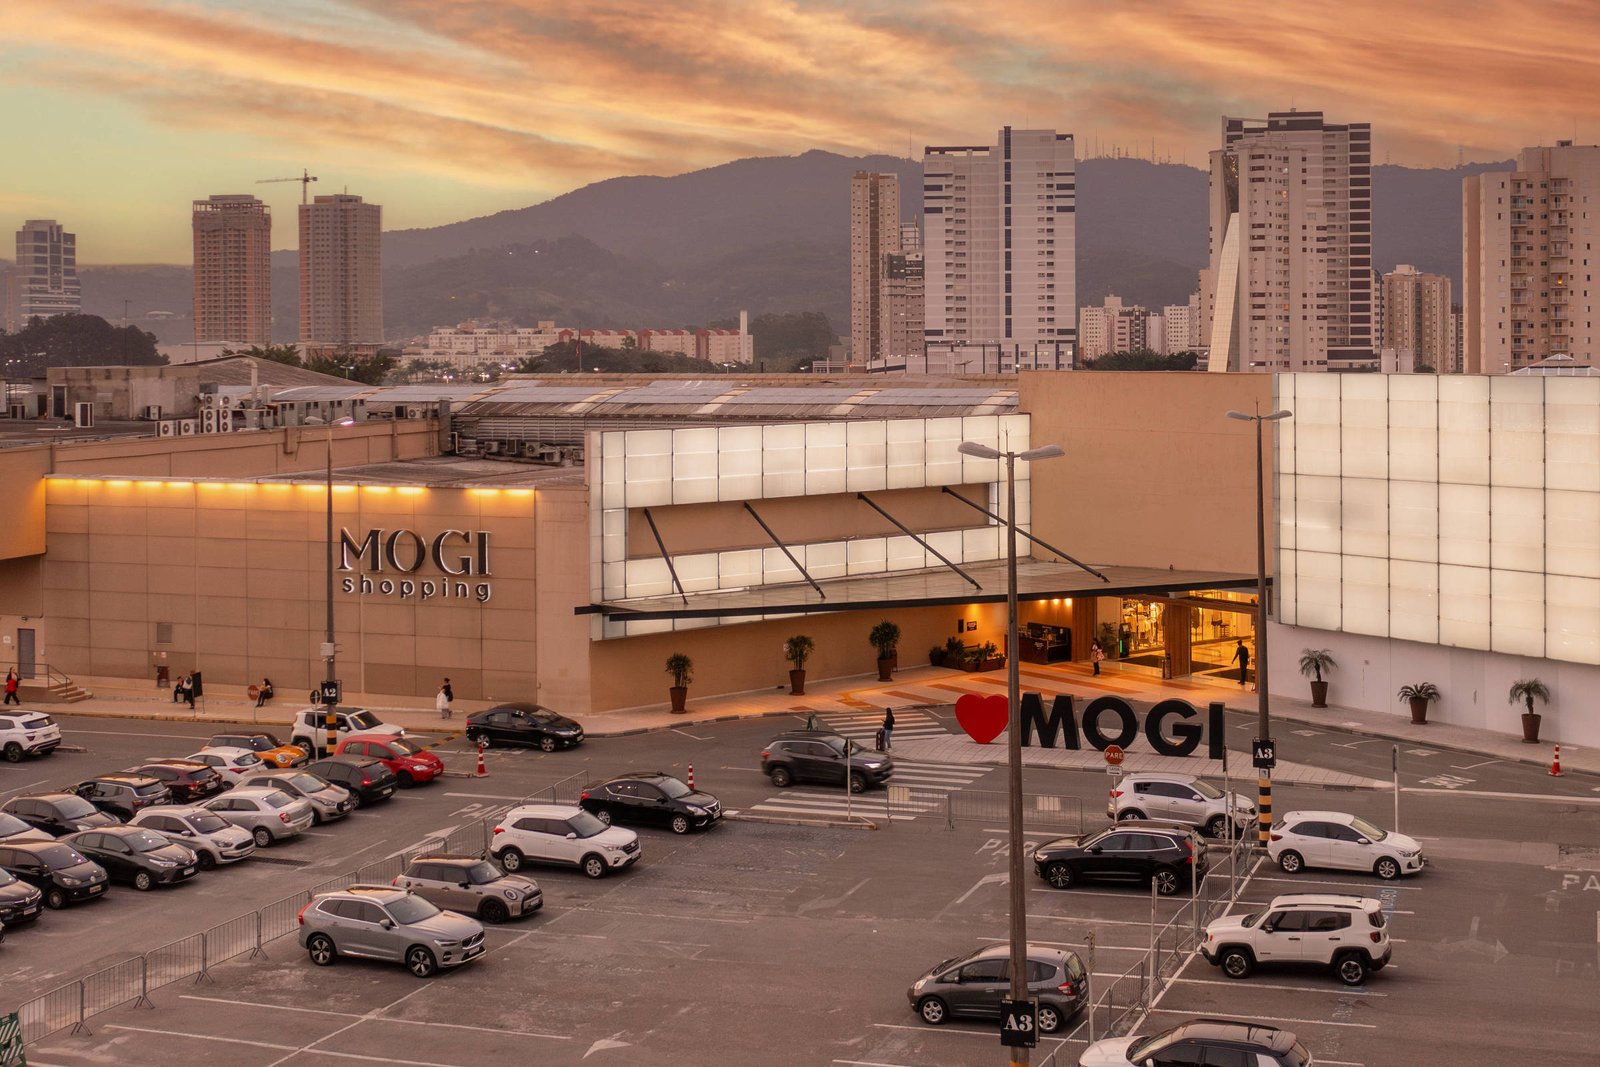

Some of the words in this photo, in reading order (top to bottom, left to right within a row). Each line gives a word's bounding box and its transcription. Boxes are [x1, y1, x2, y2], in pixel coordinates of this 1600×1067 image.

[337, 527, 492, 575] MOGI
[342, 573, 491, 602] shopping
[322, 687, 337, 697] A2
[1020, 692, 1225, 759] MOGI
[1105, 752, 1123, 760] PARE
[1255, 747, 1273, 759] A3
[1003, 1013, 1033, 1031] A3
